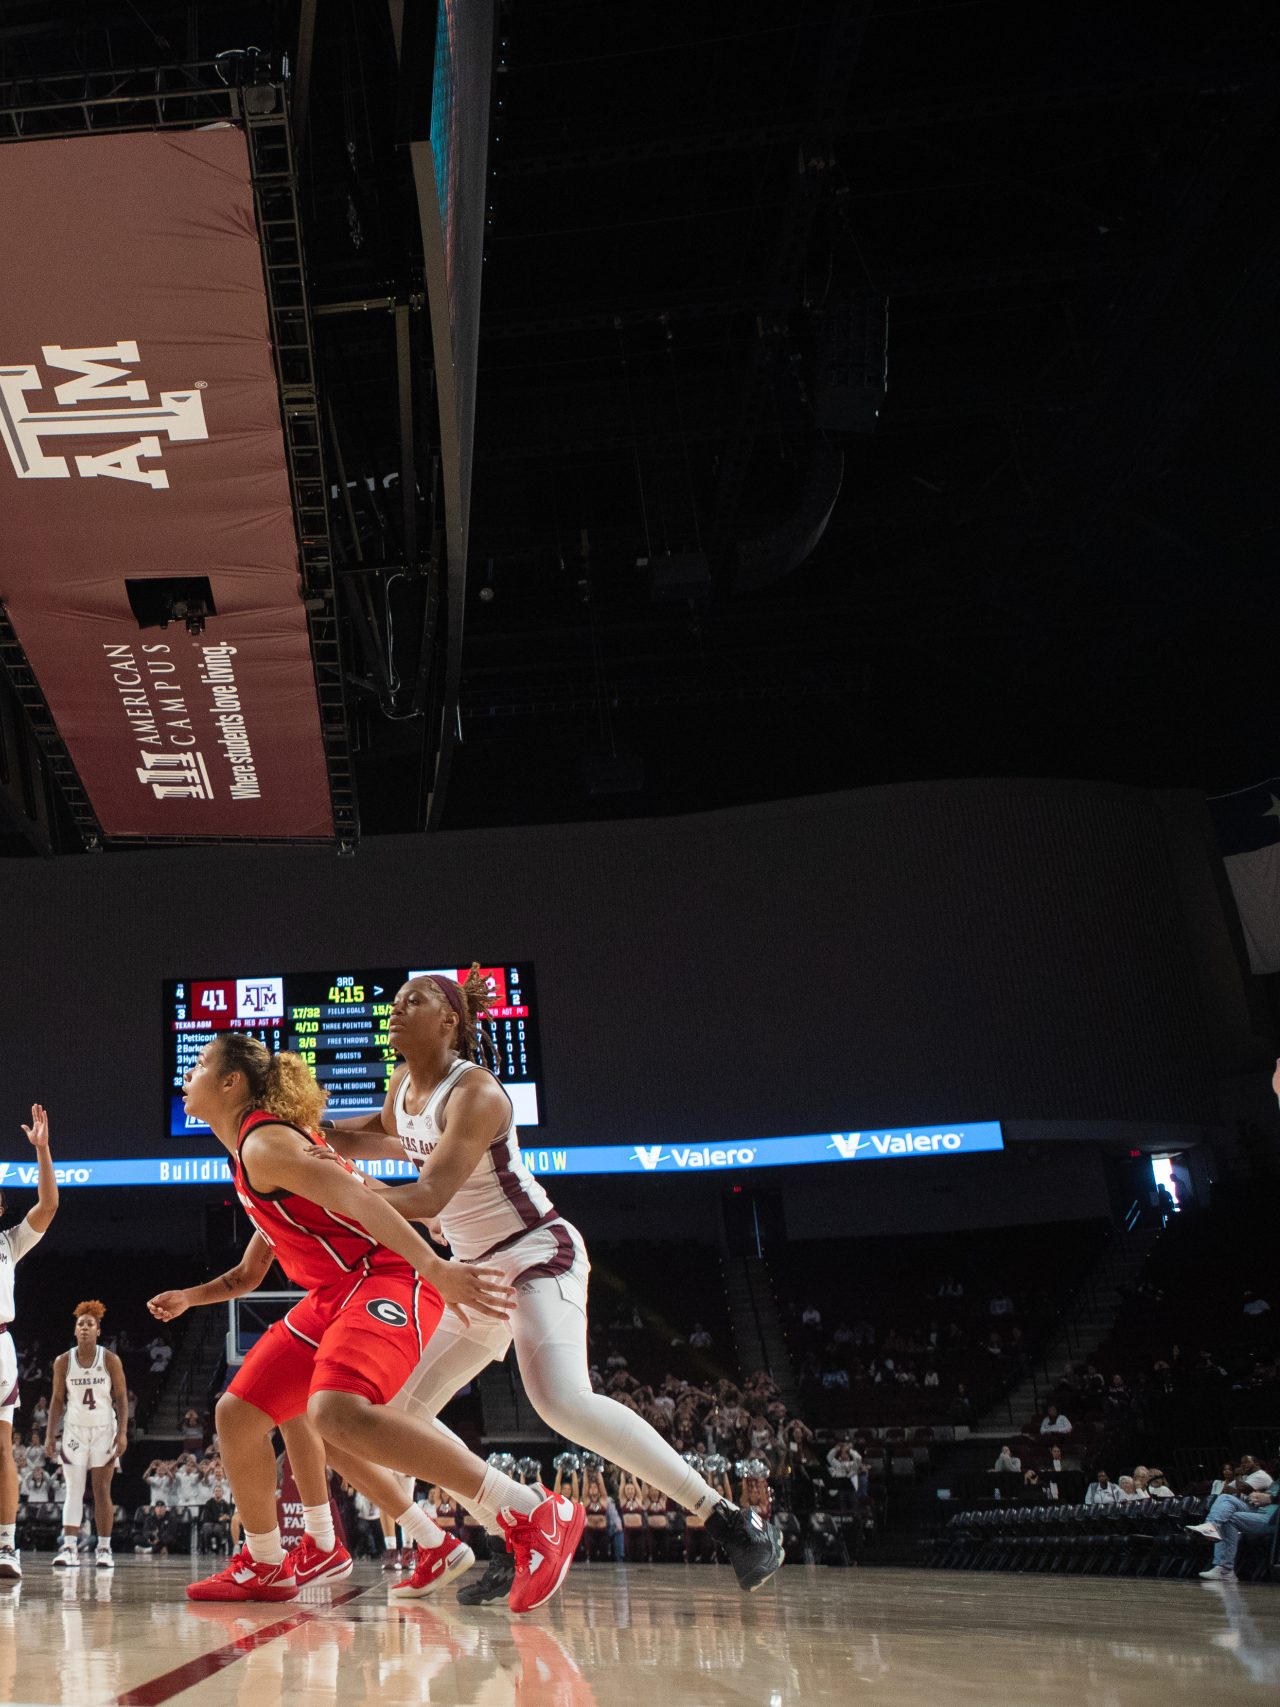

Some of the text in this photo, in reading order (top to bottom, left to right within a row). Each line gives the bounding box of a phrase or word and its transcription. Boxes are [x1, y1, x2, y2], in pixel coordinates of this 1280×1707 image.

[103, 643, 162, 746] AMERICAN
[141, 643, 196, 746] CAMPUS
[209, 685, 241, 713] love
[214, 714, 254, 763] students
[229, 767, 262, 800] Where
[336, 976, 354, 987] 3RD
[510, 972, 519, 984] 3
[176, 988, 184, 999] 4
[328, 985, 365, 1003] 4:15
[512, 994, 520, 1005] 2
[201, 989, 228, 1011] 41
[177, 1009, 186, 1020] 3
[292, 1007, 321, 1019] 17/32
[327, 1007, 346, 1015] FIELD
[175, 1021, 195, 1030] TEXAS
[258, 1018, 269, 1026] AST
[272, 1017, 280, 1025] PF
[295, 1021, 319, 1033] 4/10
[322, 1022, 342, 1031] THREE
[342, 1020, 372, 1030] POINTERS
[505, 1021, 511, 1031] 2
[518, 1020, 524, 1030] 0
[298, 1033, 391, 1048] 3/6 FREE THROWS 10/
[506, 1032, 512, 1041] 4
[519, 1031, 525, 1040] 0
[506, 1042, 513, 1052] 0
[520, 1042, 525, 1052] 1
[335, 1051, 361, 1060] ASSISTS
[520, 1053, 527, 1063] 2
[331, 1066, 367, 1076] TURNOVERS
[521, 1064, 527, 1074] 1
[173, 1076, 183, 1087] 32
[324, 1081, 342, 1091] TOTAL
[343, 1081, 376, 1090] REBOUNDS
[328, 1097, 373, 1106] OFF REBOUNDS
[871, 1132, 962, 1155] Valero
[671, 1147, 755, 1168] Valero
[160, 1161, 232, 1181] Buildin
[524, 1150, 567, 1171] NOW
[17, 1166, 89, 1184] Vaero
[70, 1378, 91, 1386] TEXAS
[82, 1388, 97, 1411] 4
